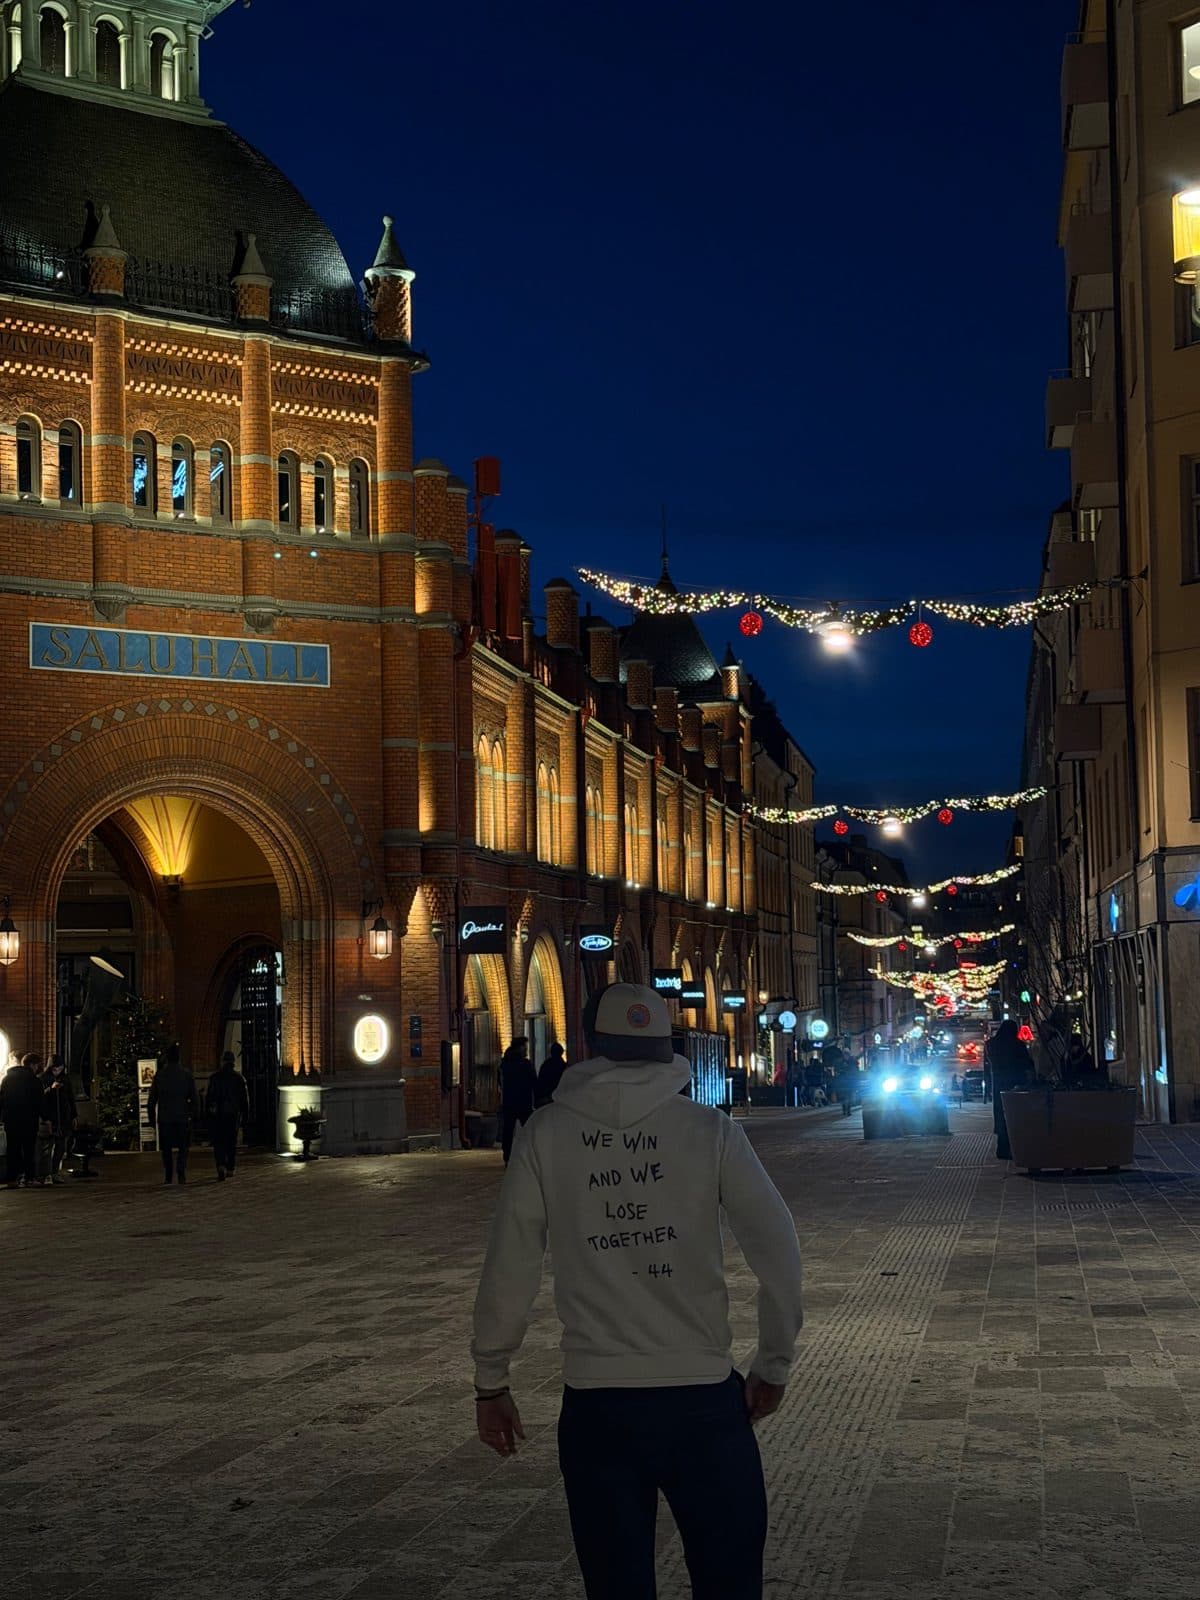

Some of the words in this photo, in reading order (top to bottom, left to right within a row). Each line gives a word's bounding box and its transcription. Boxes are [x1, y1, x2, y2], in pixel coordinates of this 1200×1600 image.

[41, 628, 320, 682] SALUHALL
[582, 1130, 614, 1152] WE
[623, 1131, 658, 1155] WIN
[588, 1170, 622, 1191] AND
[630, 1162, 664, 1185] WE
[605, 1201, 648, 1221] LOSE
[587, 1226, 677, 1252] TOGETHER
[648, 1263, 673, 1278] 44
